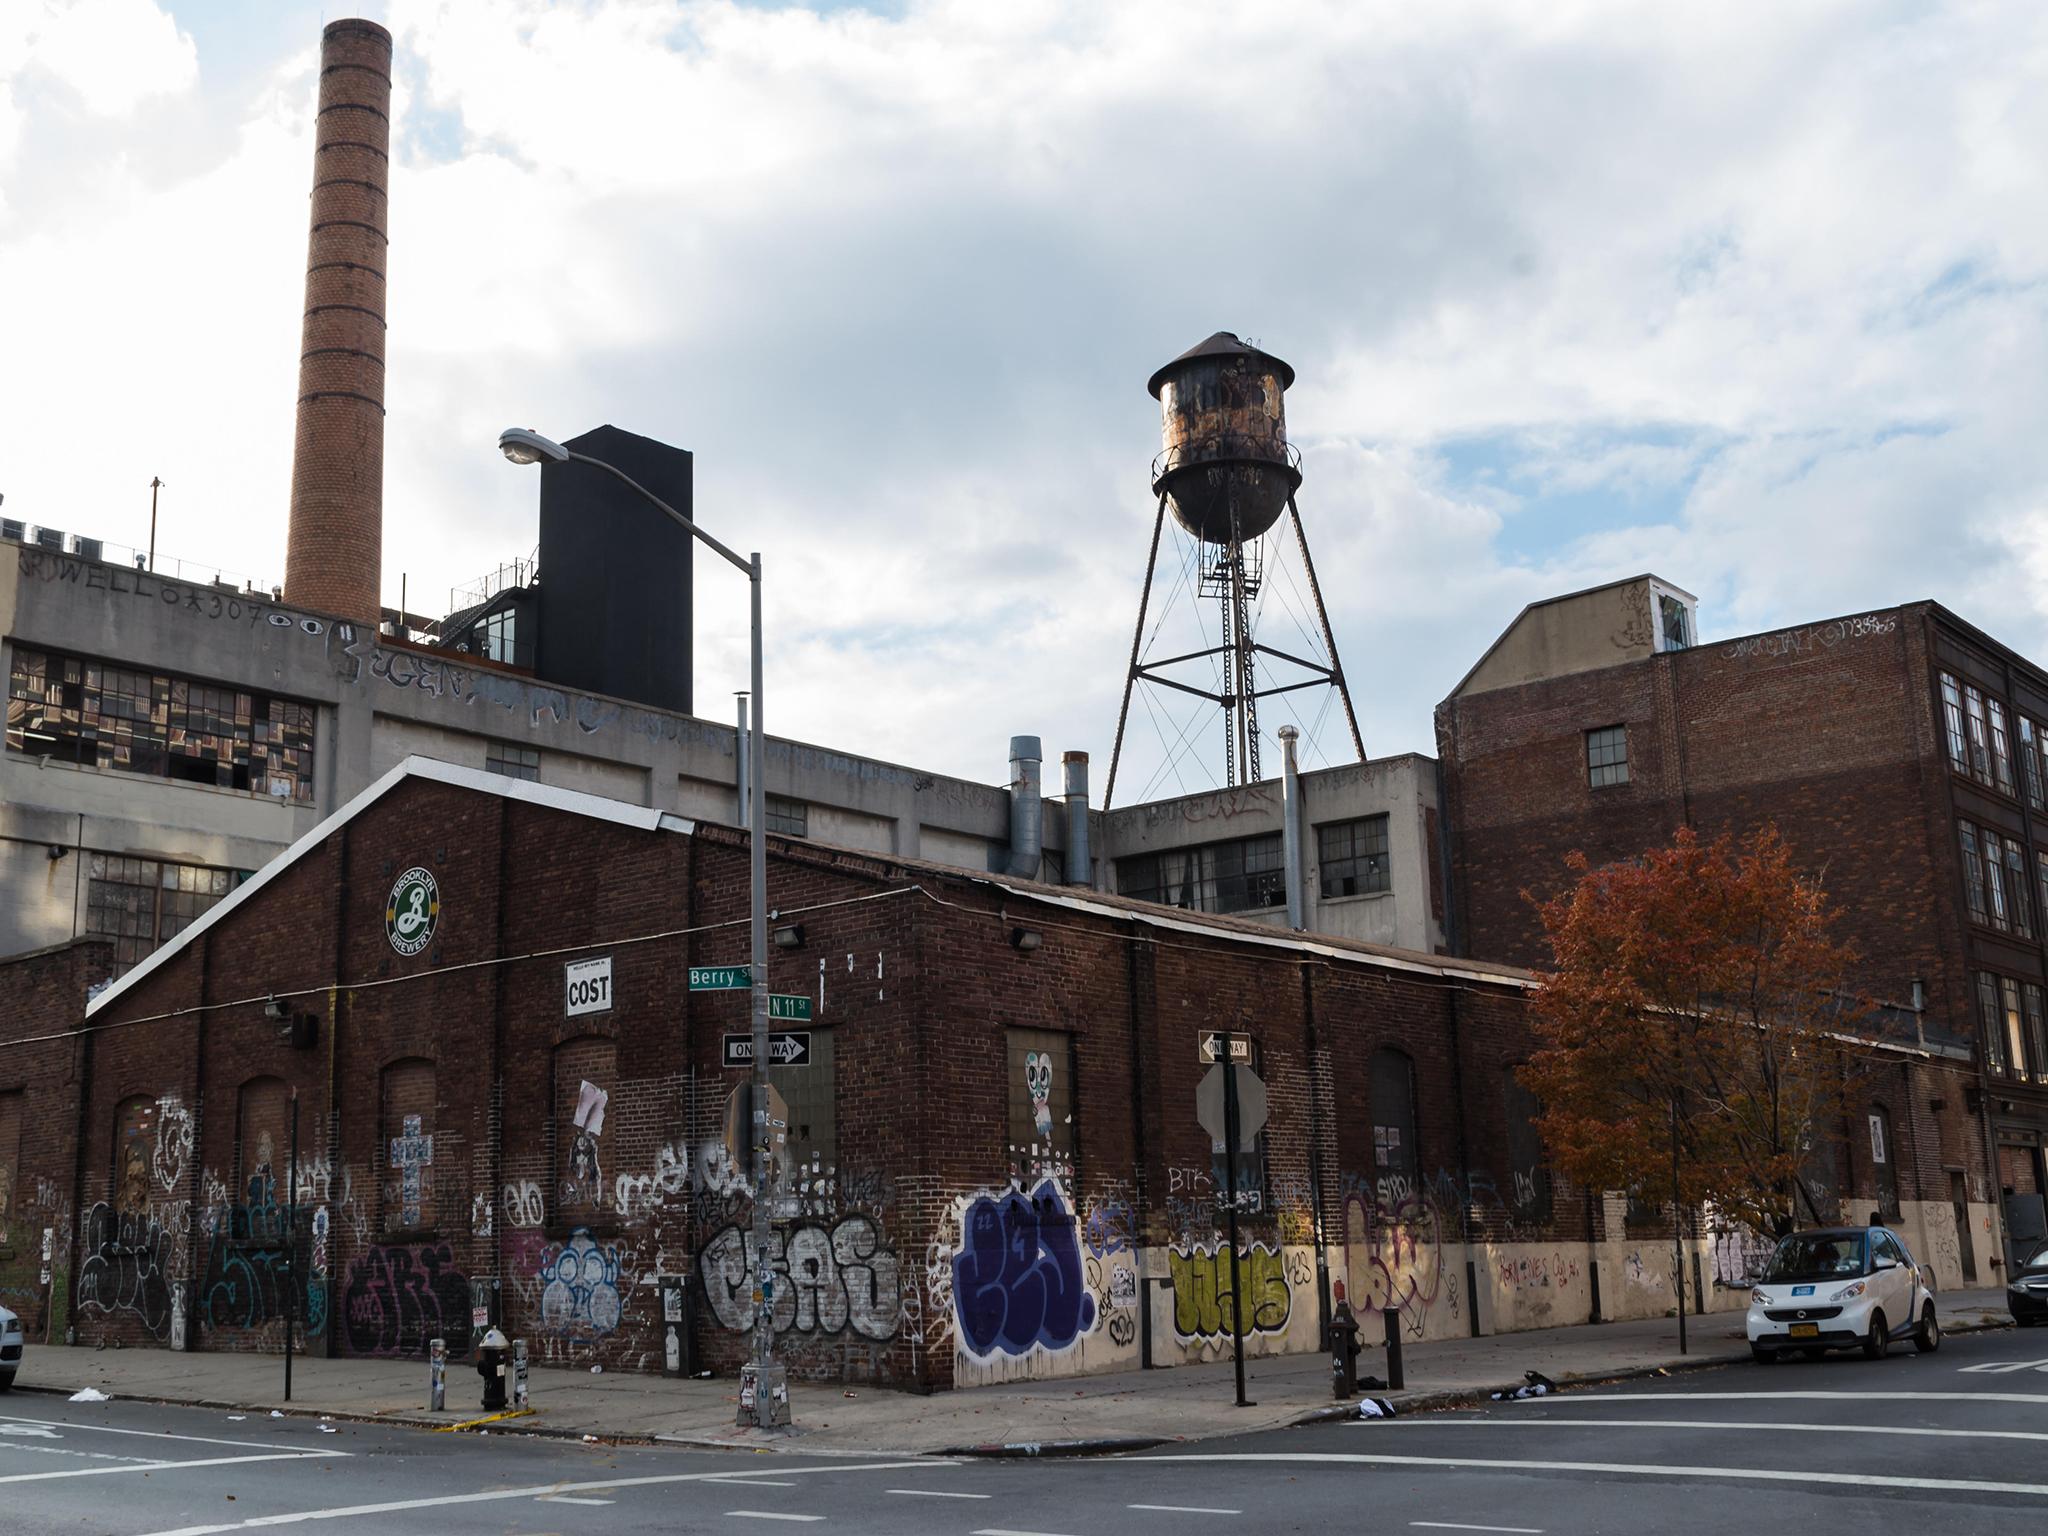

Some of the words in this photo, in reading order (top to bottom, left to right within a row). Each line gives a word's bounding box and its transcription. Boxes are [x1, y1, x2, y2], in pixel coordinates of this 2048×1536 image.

[394, 870, 435, 897] BROOKLYN
[391, 927, 431, 953] BREWERY
[691, 970, 734, 986] Berry
[569, 975, 609, 1007] COST
[772, 998, 780, 1016] N
[785, 998, 794, 1017] 11
[798, 1001, 806, 1010] St
[736, 1044, 753, 1056] ON
[771, 1044, 796, 1055] WAY
[1208, 1040, 1222, 1053] ON
[1168, 1167, 1213, 1193] BTK
